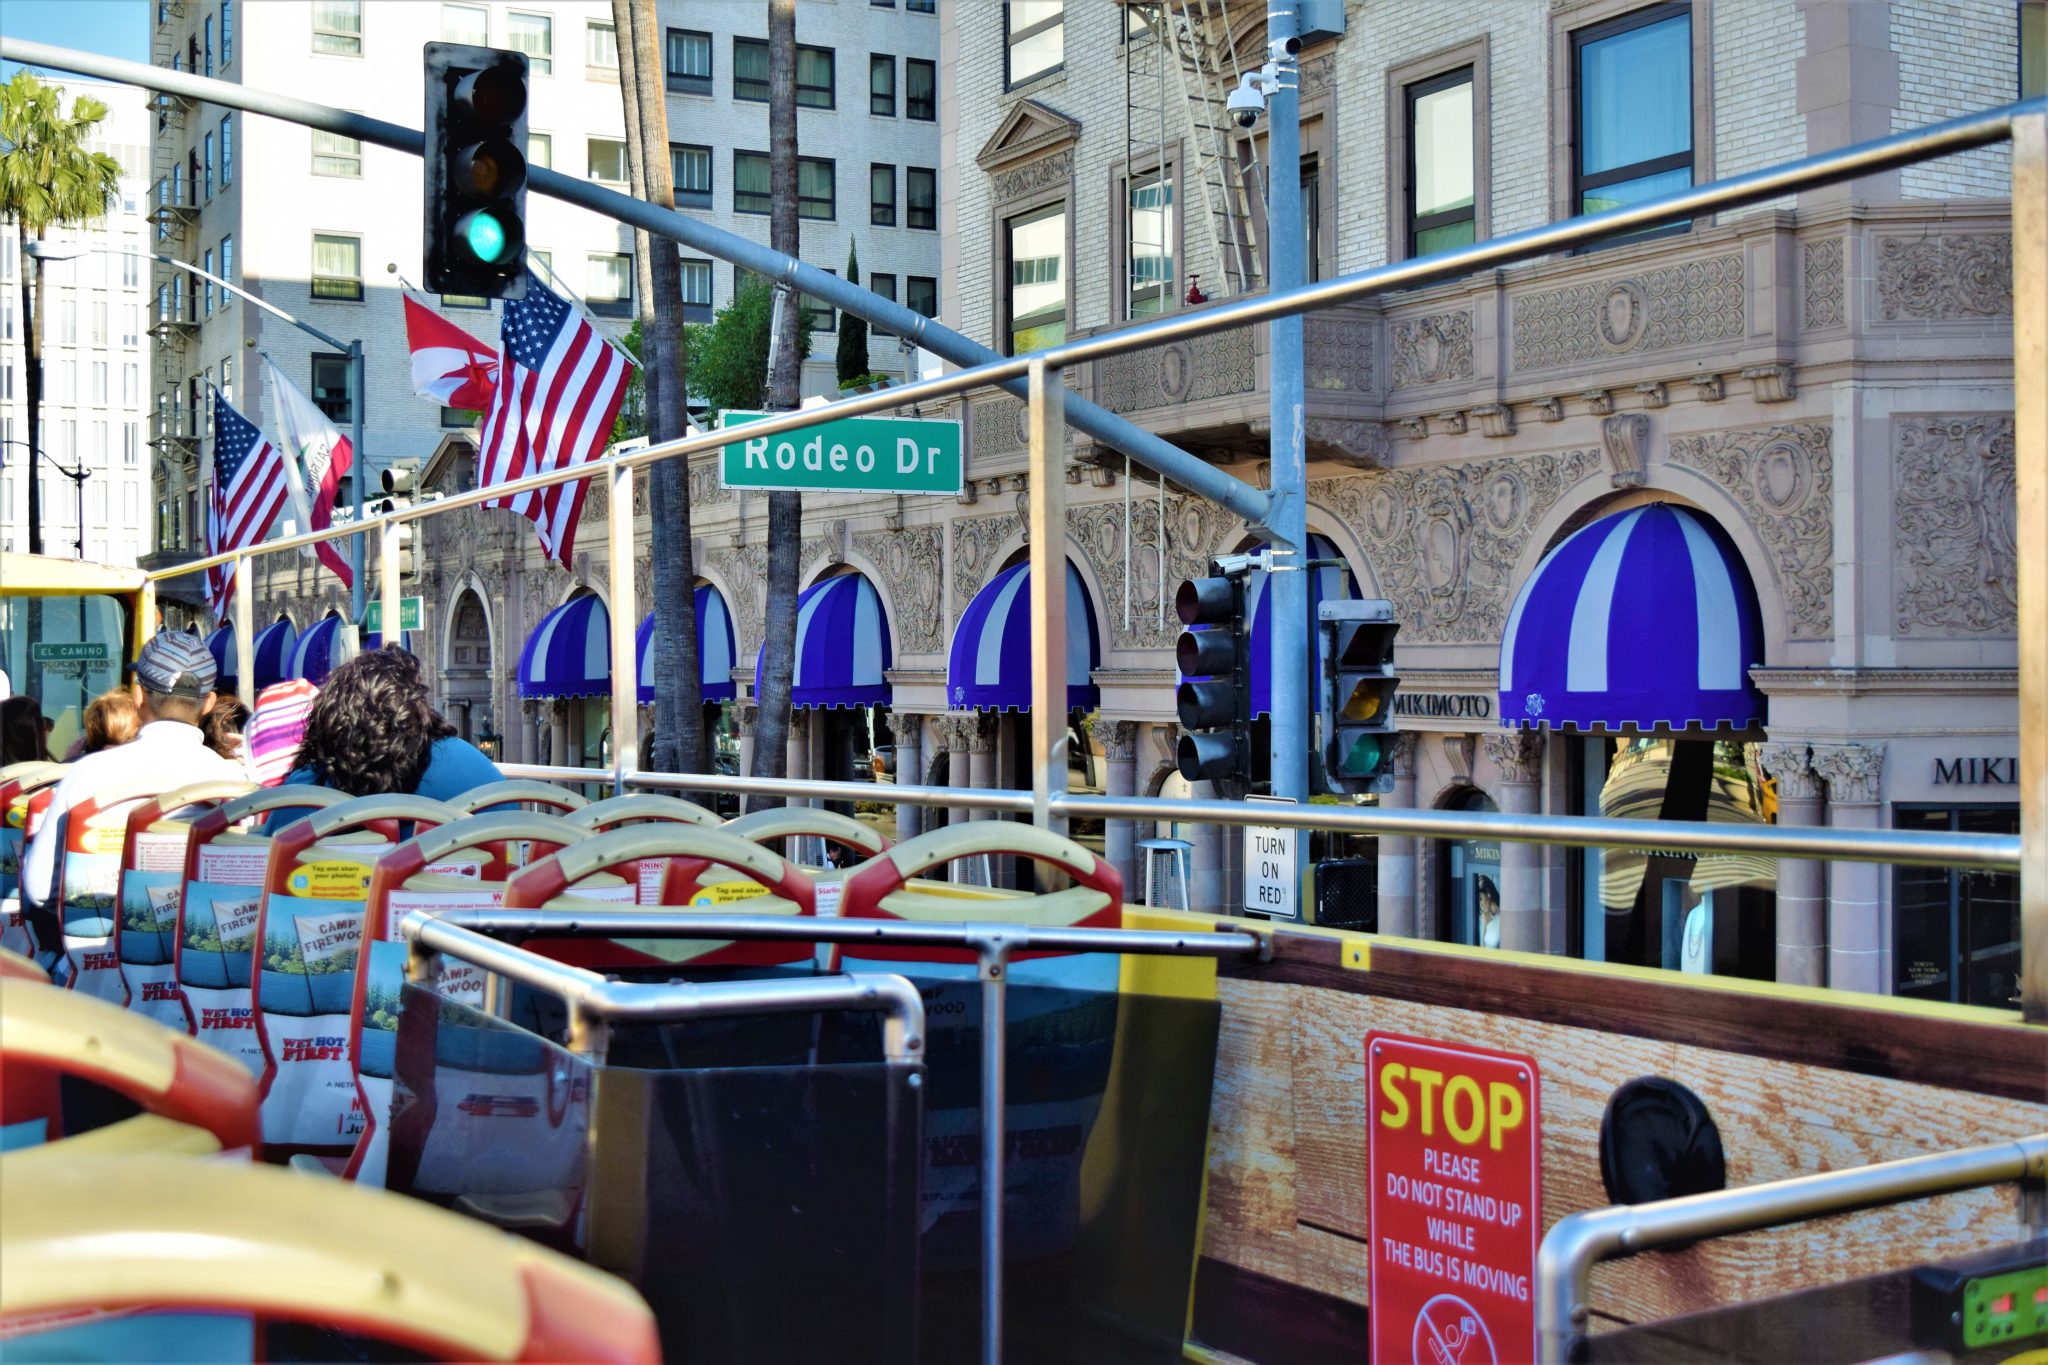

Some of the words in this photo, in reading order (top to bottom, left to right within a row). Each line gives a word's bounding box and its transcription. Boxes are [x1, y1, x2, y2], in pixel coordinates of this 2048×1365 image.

[745, 435, 876, 472] Rodeo
[896, 437, 941, 475] Dr
[41, 648, 54, 656] EL
[61, 647, 103, 656] CAMINO
[1394, 693, 1490, 718] MIKIMOTO
[1932, 757, 2019, 784] MIKI
[1255, 836, 1285, 855] TURN
[1261, 861, 1279, 879] ON
[1259, 886, 1281, 905] RED
[233, 903, 260, 917] CAM
[221, 914, 259, 933] FIREW
[320, 920, 356, 934] CAMP
[202, 1009, 229, 1017] WET
[282, 1038, 314, 1048] WET
[315, 1037, 346, 1046] HOT
[282, 1047, 344, 1061] FIRST
[1380, 1062, 1523, 1151] STOP
[1424, 1147, 1480, 1183] PLEASE
[1387, 1172, 1409, 1199] DO
[1411, 1178, 1443, 1208] NOT
[1445, 1187, 1497, 1221] STAND
[1500, 1199, 1522, 1227] UP
[1426, 1215, 1475, 1251] WHILE
[1382, 1237, 1412, 1268] THE
[1413, 1246, 1443, 1277] BUS
[1446, 1255, 1460, 1282] IS
[1463, 1260, 1527, 1301] MOVING
